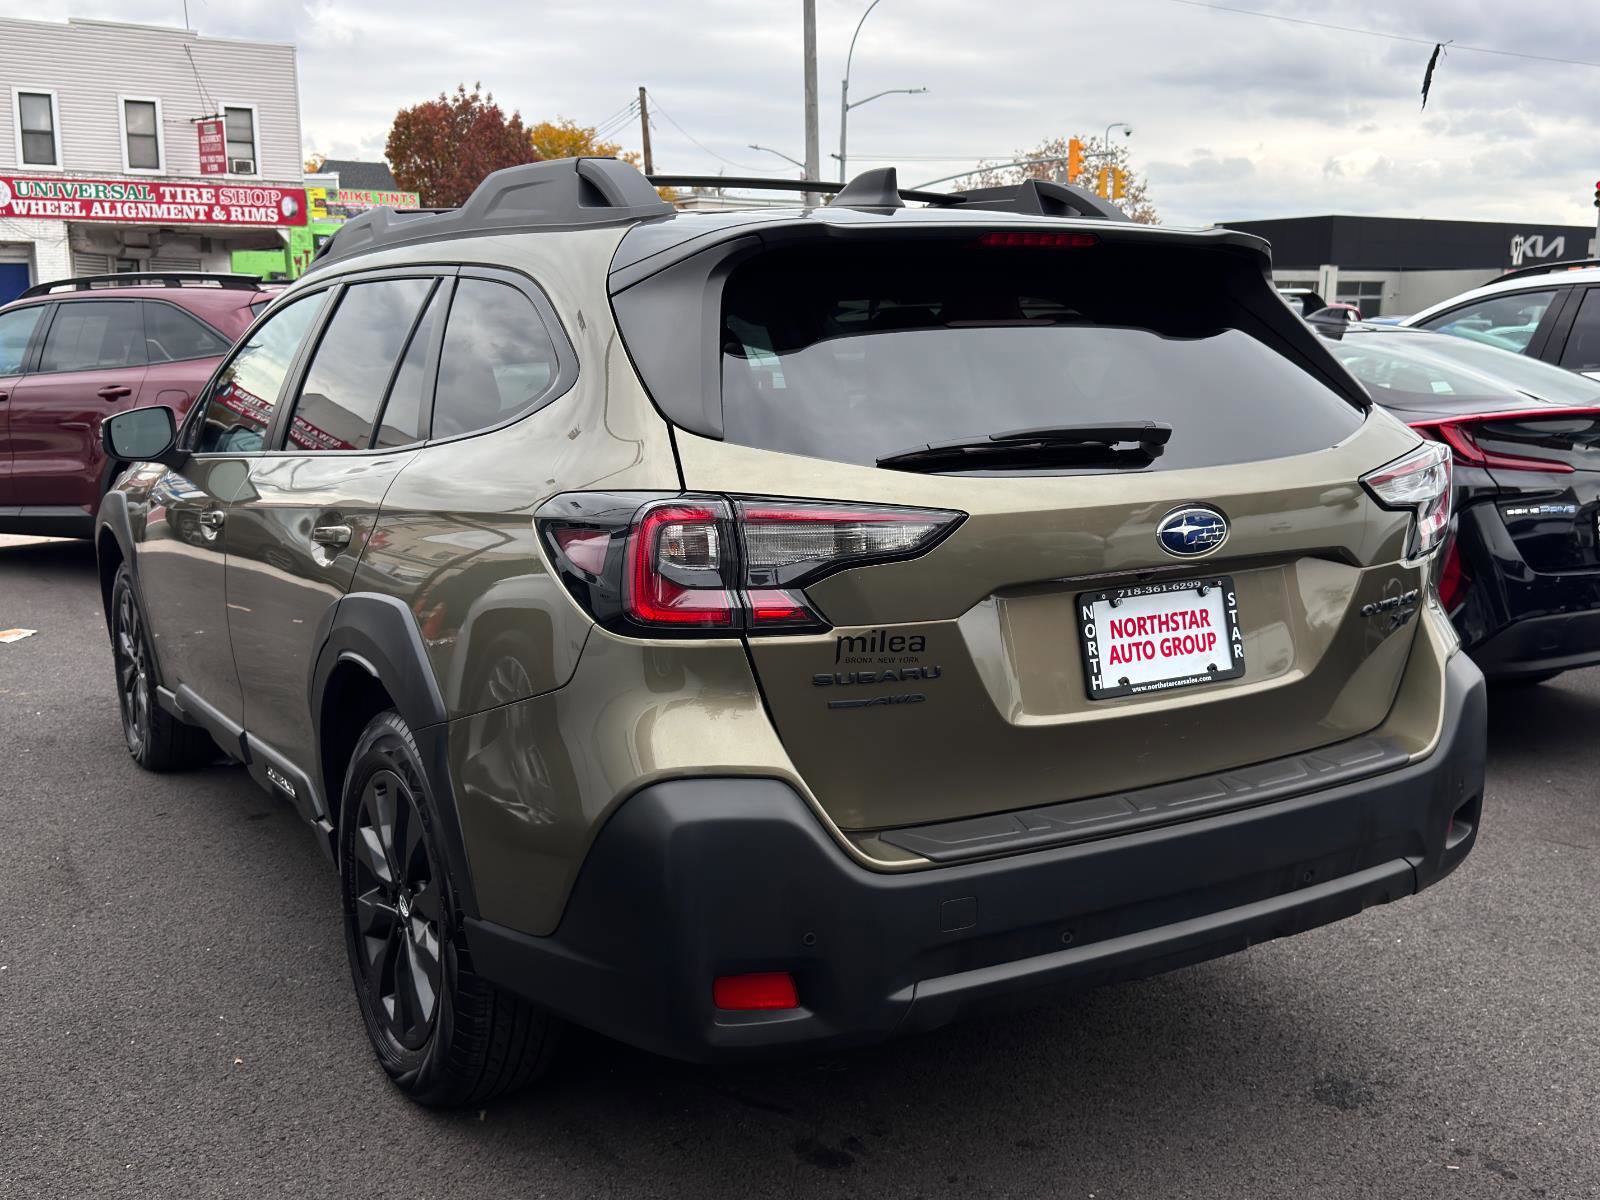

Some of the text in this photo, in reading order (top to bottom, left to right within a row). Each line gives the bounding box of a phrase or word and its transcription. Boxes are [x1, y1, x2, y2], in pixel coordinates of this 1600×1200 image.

[13, 180, 281, 207] UNIVERSAL TIRE SHOP
[339, 191, 373, 203] MIKE
[378, 193, 417, 205] TINTS
[10, 200, 86, 217] WHEEL
[90, 202, 208, 220] ALIGNMENT
[211, 205, 227, 221] &
[229, 207, 279, 222] RIMS
[1117, 580, 1201, 598] 718-361-6299
[1109, 608, 1211, 640] NORTHSTAR
[1227, 592, 1243, 658] STAR
[835, 629, 926, 665] milea
[1082, 605, 1103, 690] NORTH
[1109, 632, 1217, 665] AUTO GROUP
[845, 656, 919, 664] BRONX NEW YORK
[812, 665, 941, 686] SUBARU
[1131, 675, 1212, 693] www.northstarcarsales.com
